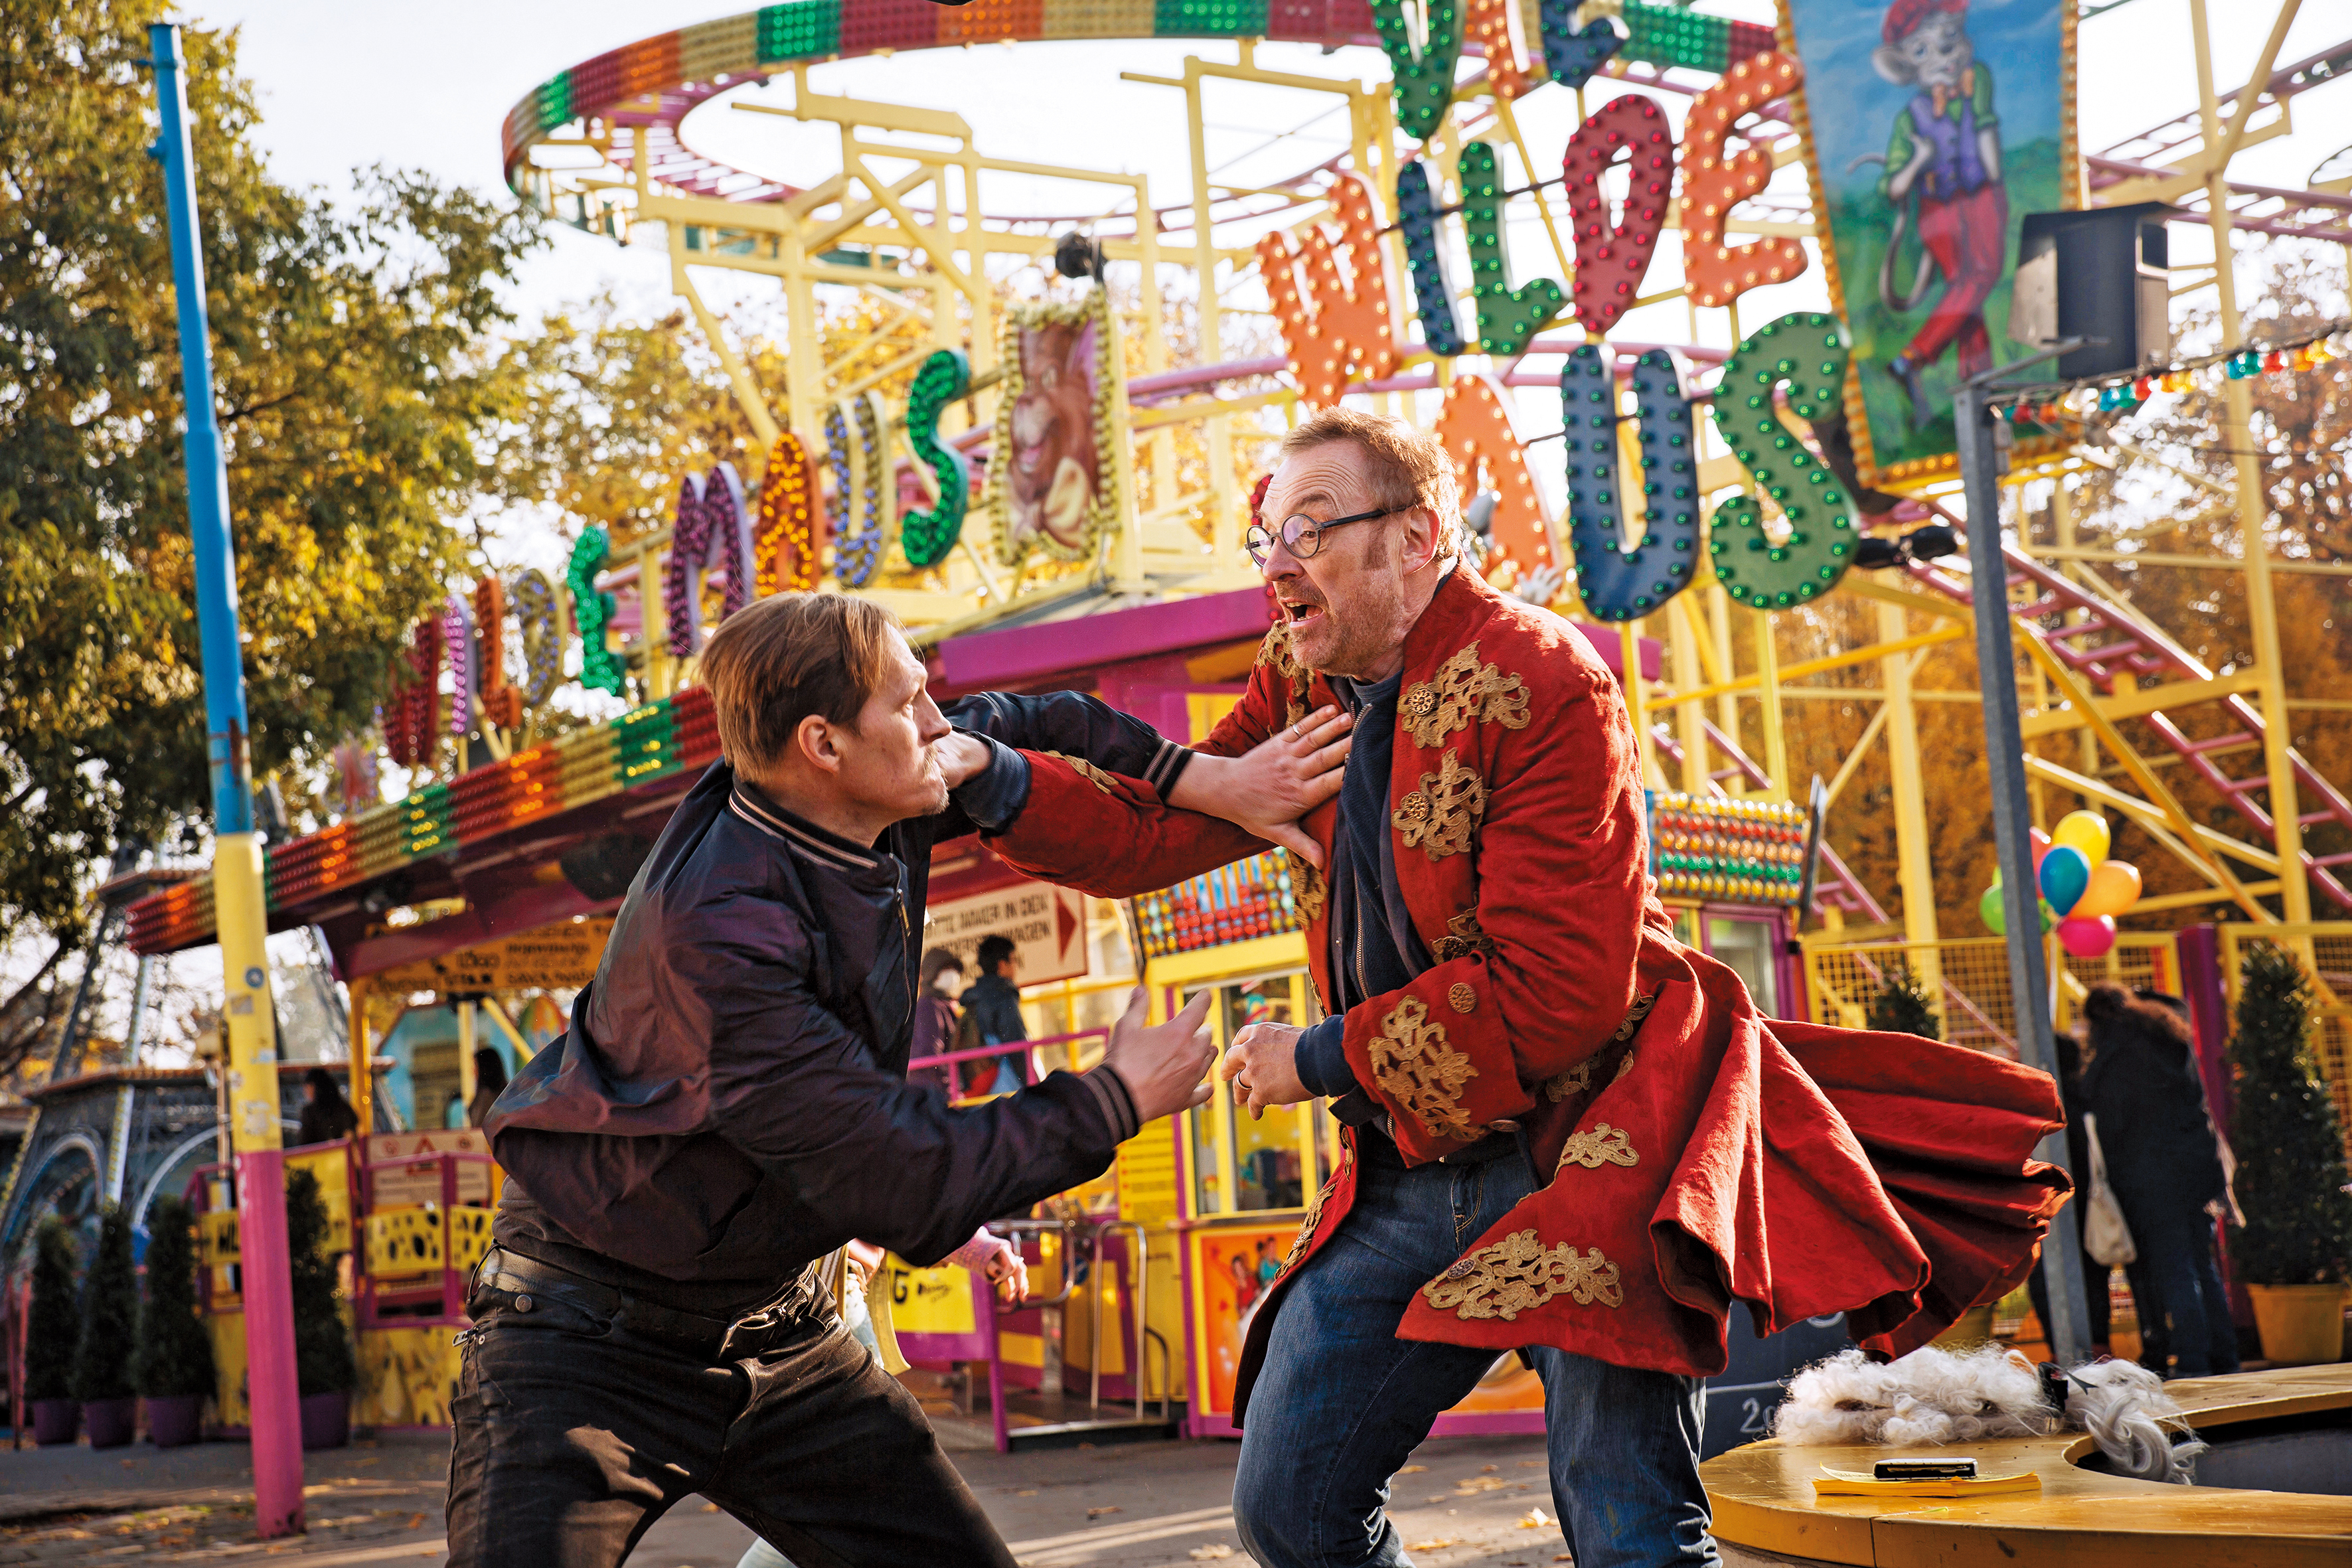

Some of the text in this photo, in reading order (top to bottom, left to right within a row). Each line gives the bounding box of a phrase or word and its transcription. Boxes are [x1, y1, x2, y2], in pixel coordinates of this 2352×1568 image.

[1256, 50, 1808, 408] WILDE
[668, 347, 971, 659] MAUS
[1251, 312, 1859, 622] AUS
